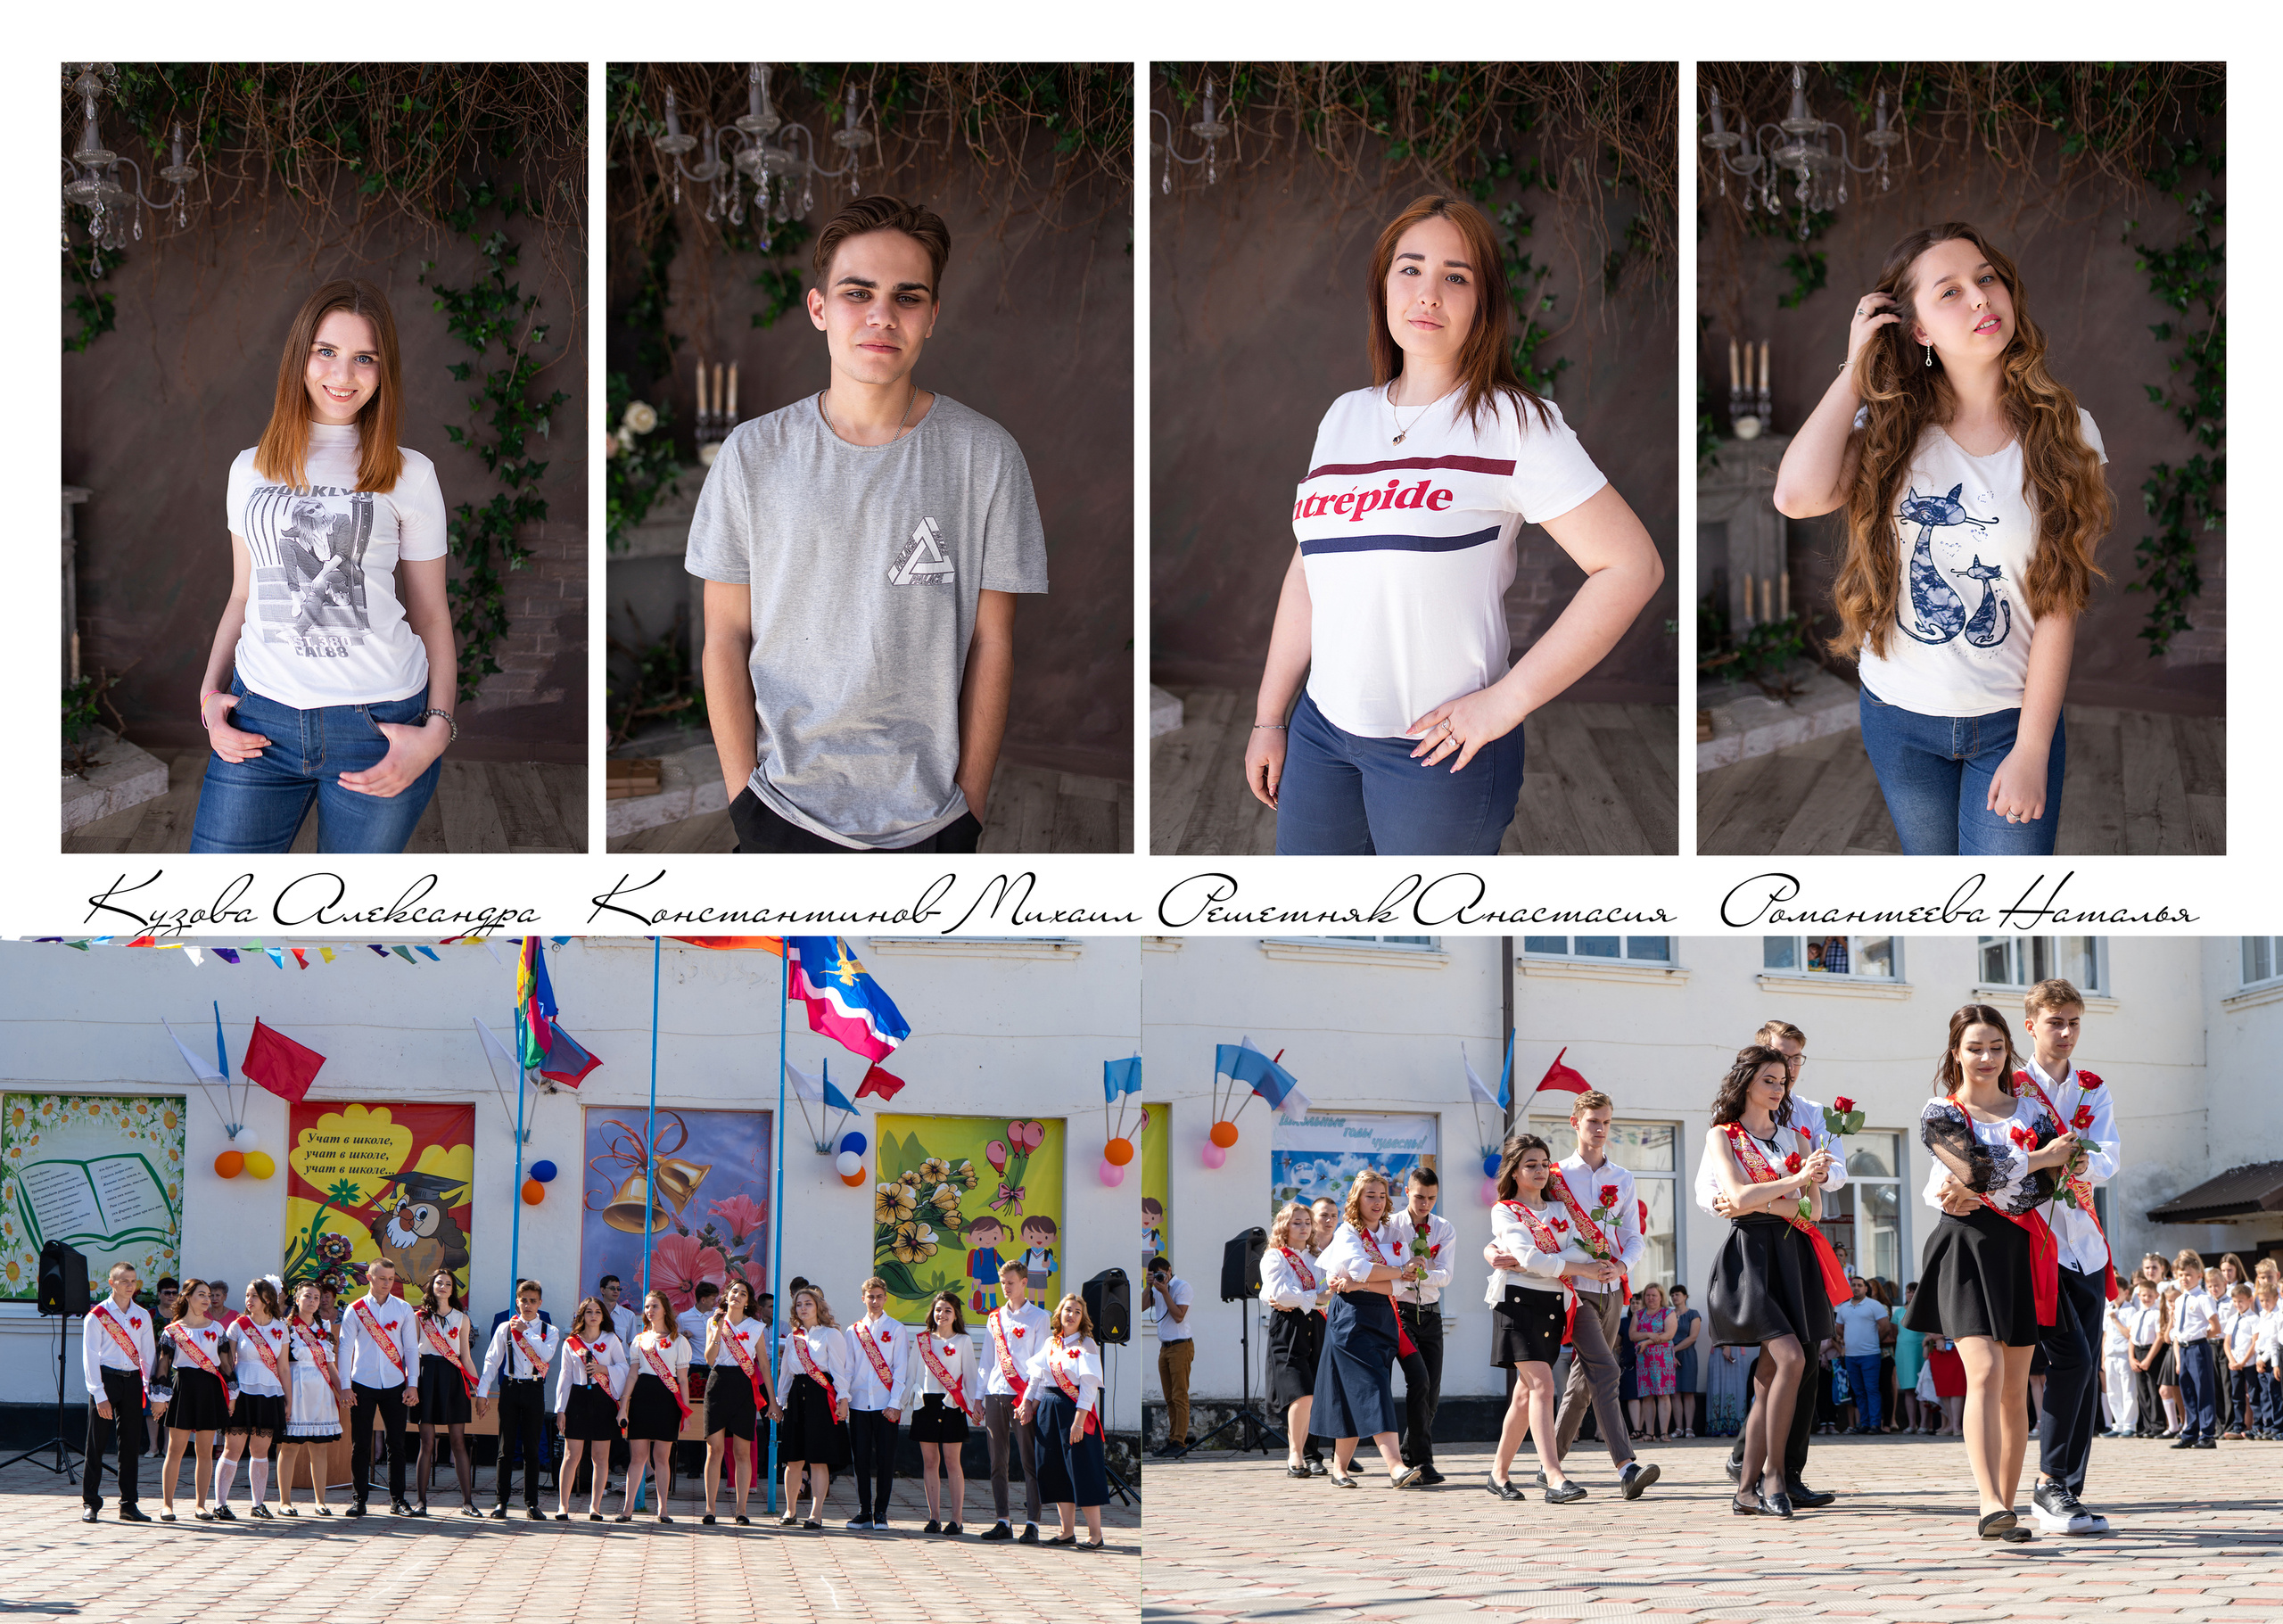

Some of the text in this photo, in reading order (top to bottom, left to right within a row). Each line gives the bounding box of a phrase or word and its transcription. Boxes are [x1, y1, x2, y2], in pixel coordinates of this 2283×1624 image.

[308, 1133, 393, 1146] Учат в школе,
[304, 1150, 336, 1160] учат
[349, 1151, 389, 1161] школе,
[303, 1165, 335, 1175] учат
[349, 1166, 395, 1175] школе...
